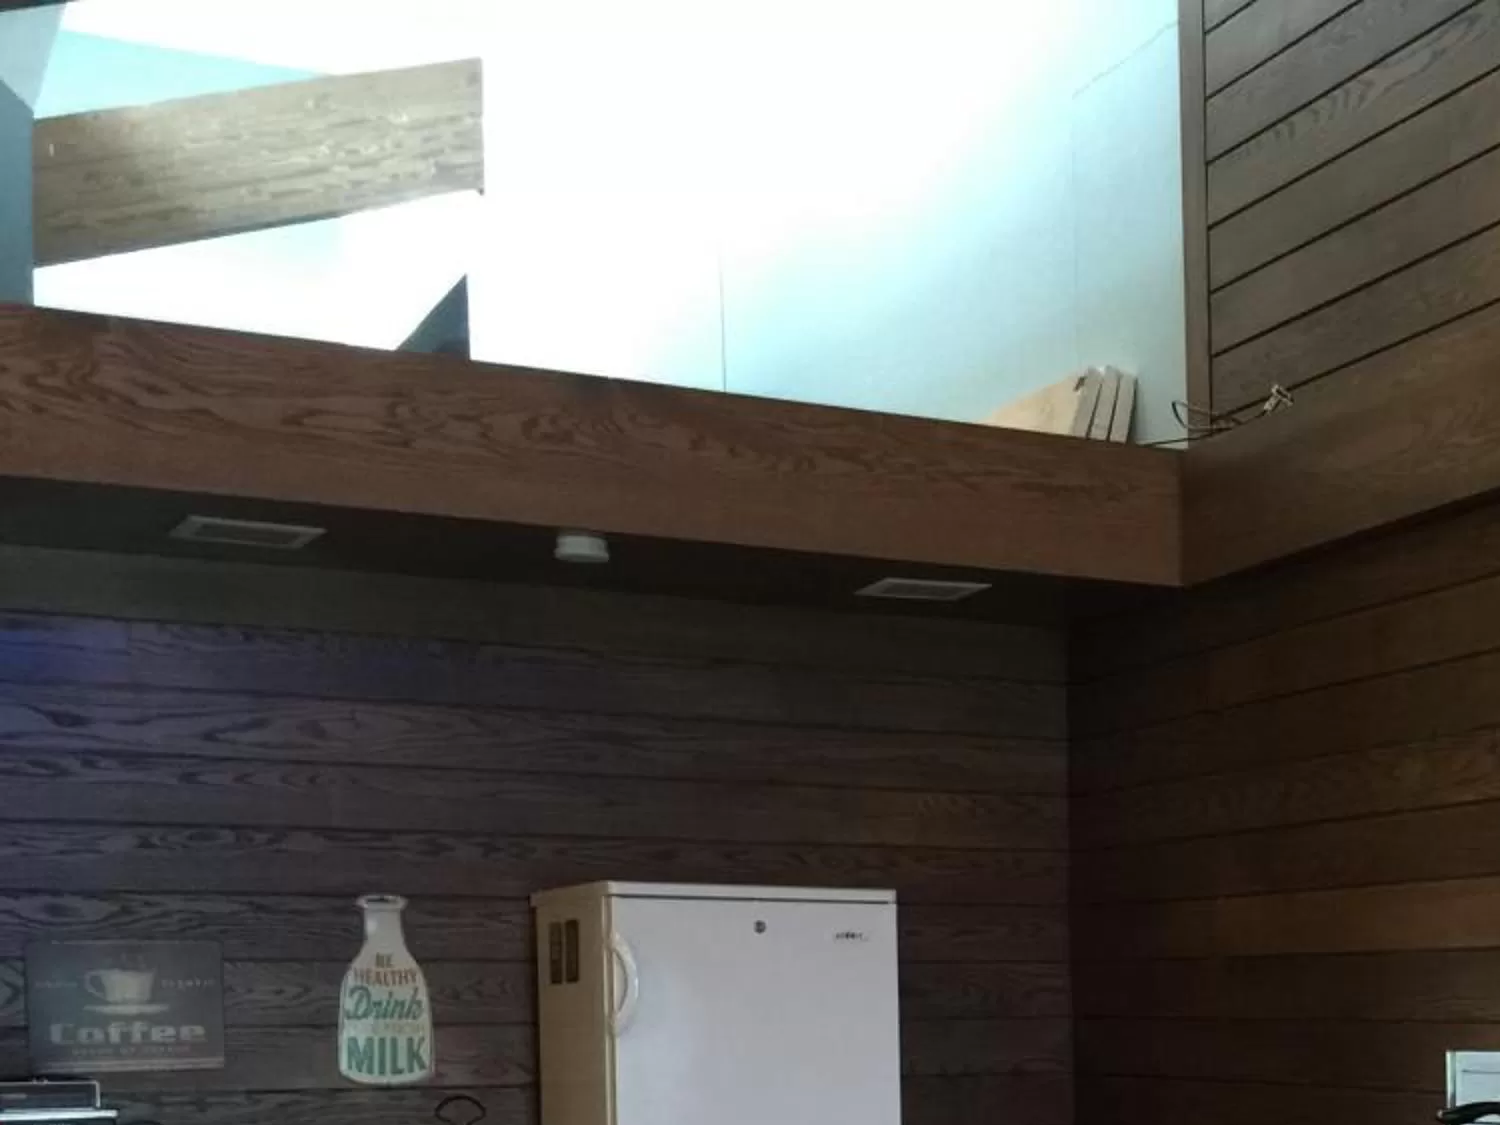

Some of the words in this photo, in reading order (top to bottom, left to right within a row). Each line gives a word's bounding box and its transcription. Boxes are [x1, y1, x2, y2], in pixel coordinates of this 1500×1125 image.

[353, 967, 418, 986] HEALTHY
[345, 985, 424, 1020] Drink
[49, 1018, 207, 1045] Coffee
[347, 1035, 428, 1075] MILK
